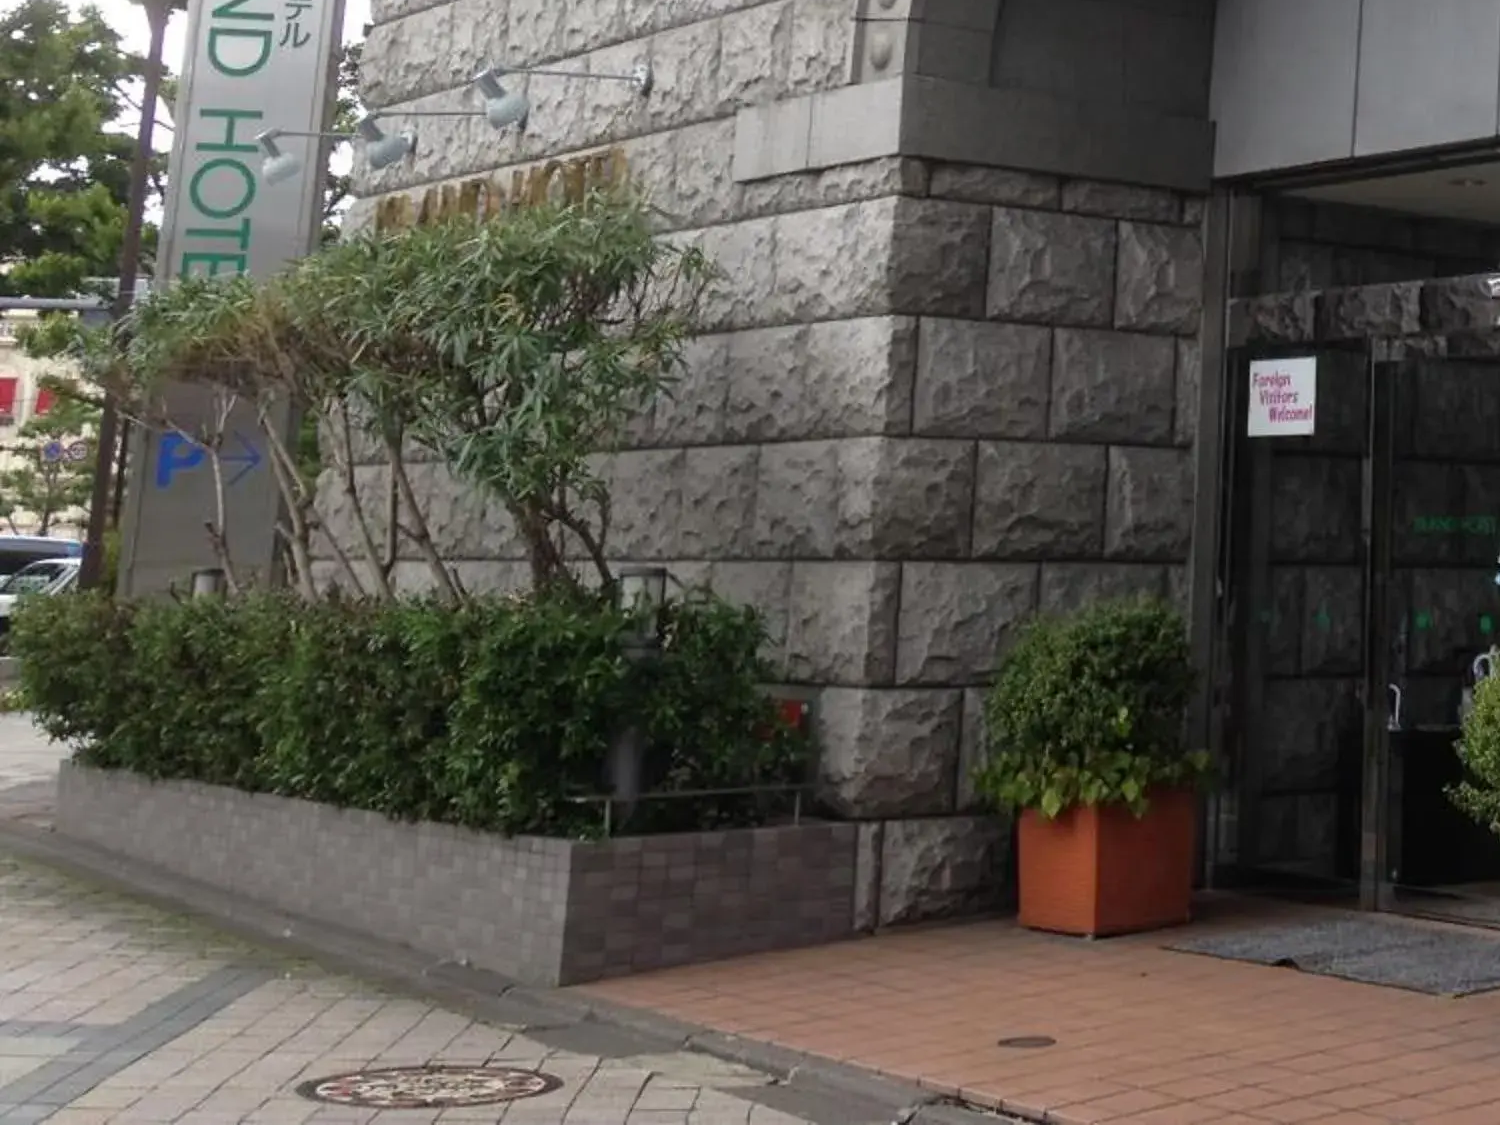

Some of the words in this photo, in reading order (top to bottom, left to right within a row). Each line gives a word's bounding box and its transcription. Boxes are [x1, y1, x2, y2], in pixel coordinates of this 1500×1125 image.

[181, 108, 263, 277] HOTE
[1252, 371, 1291, 389] Foreign
[1260, 390, 1299, 405] Visitors
[157, 431, 204, 488] P
